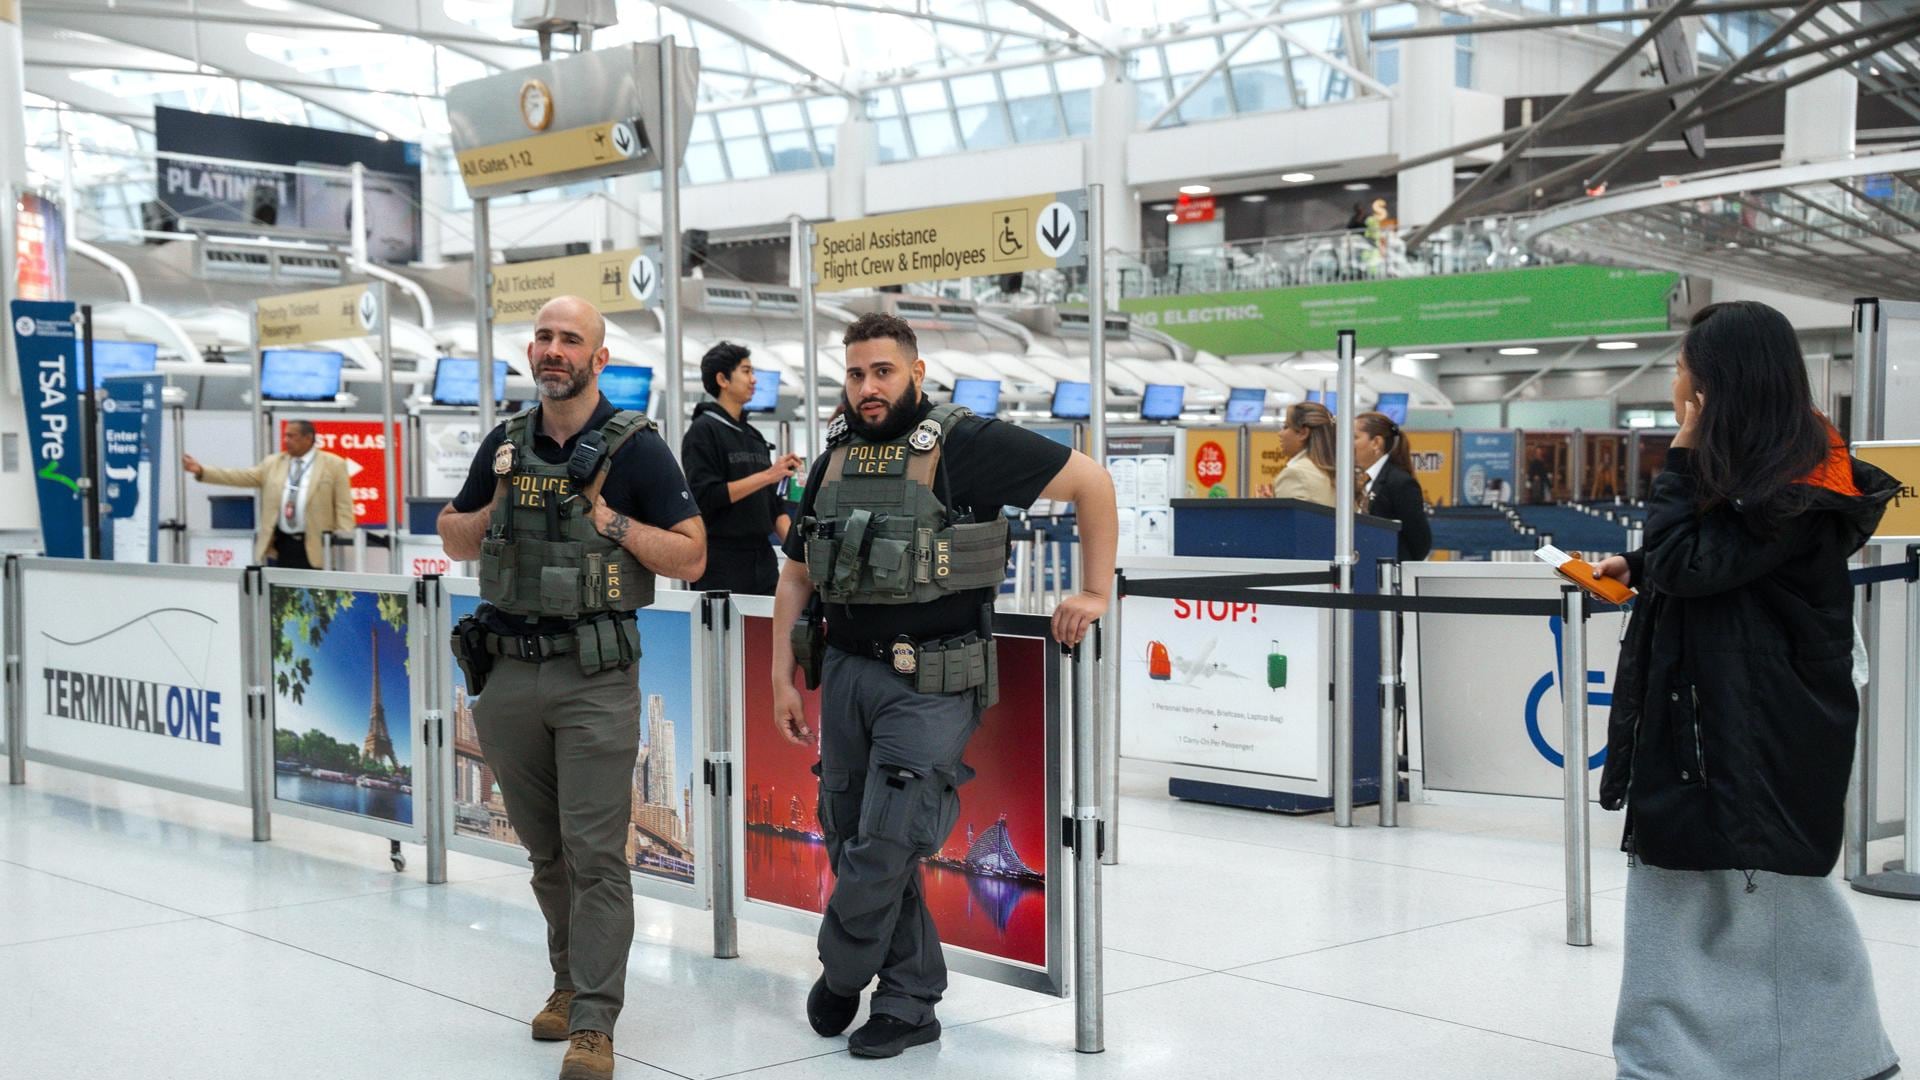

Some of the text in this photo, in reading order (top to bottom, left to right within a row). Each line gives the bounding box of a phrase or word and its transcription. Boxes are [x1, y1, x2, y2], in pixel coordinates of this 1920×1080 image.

[463, 151, 533, 177] All Gates 1-12
[823, 228, 937, 257] Special Assistance
[823, 247, 986, 283] Flight Crew & Employees
[497, 272, 555, 293] All Ticketed
[39, 354, 67, 409] TSA
[41, 414, 68, 460] Pre
[105, 429, 139, 441] Enter
[107, 442, 139, 454] Here
[848, 445, 907, 461] POLICE
[857, 461, 889, 474] ICE
[520, 494, 545, 508] IC
[413, 558, 450, 577] STOP!
[937, 542, 949, 576] ERO
[607, 564, 621, 598] ERO
[1156, 702, 1181, 713] Personal
[1247, 712, 1268, 722] Laptop
